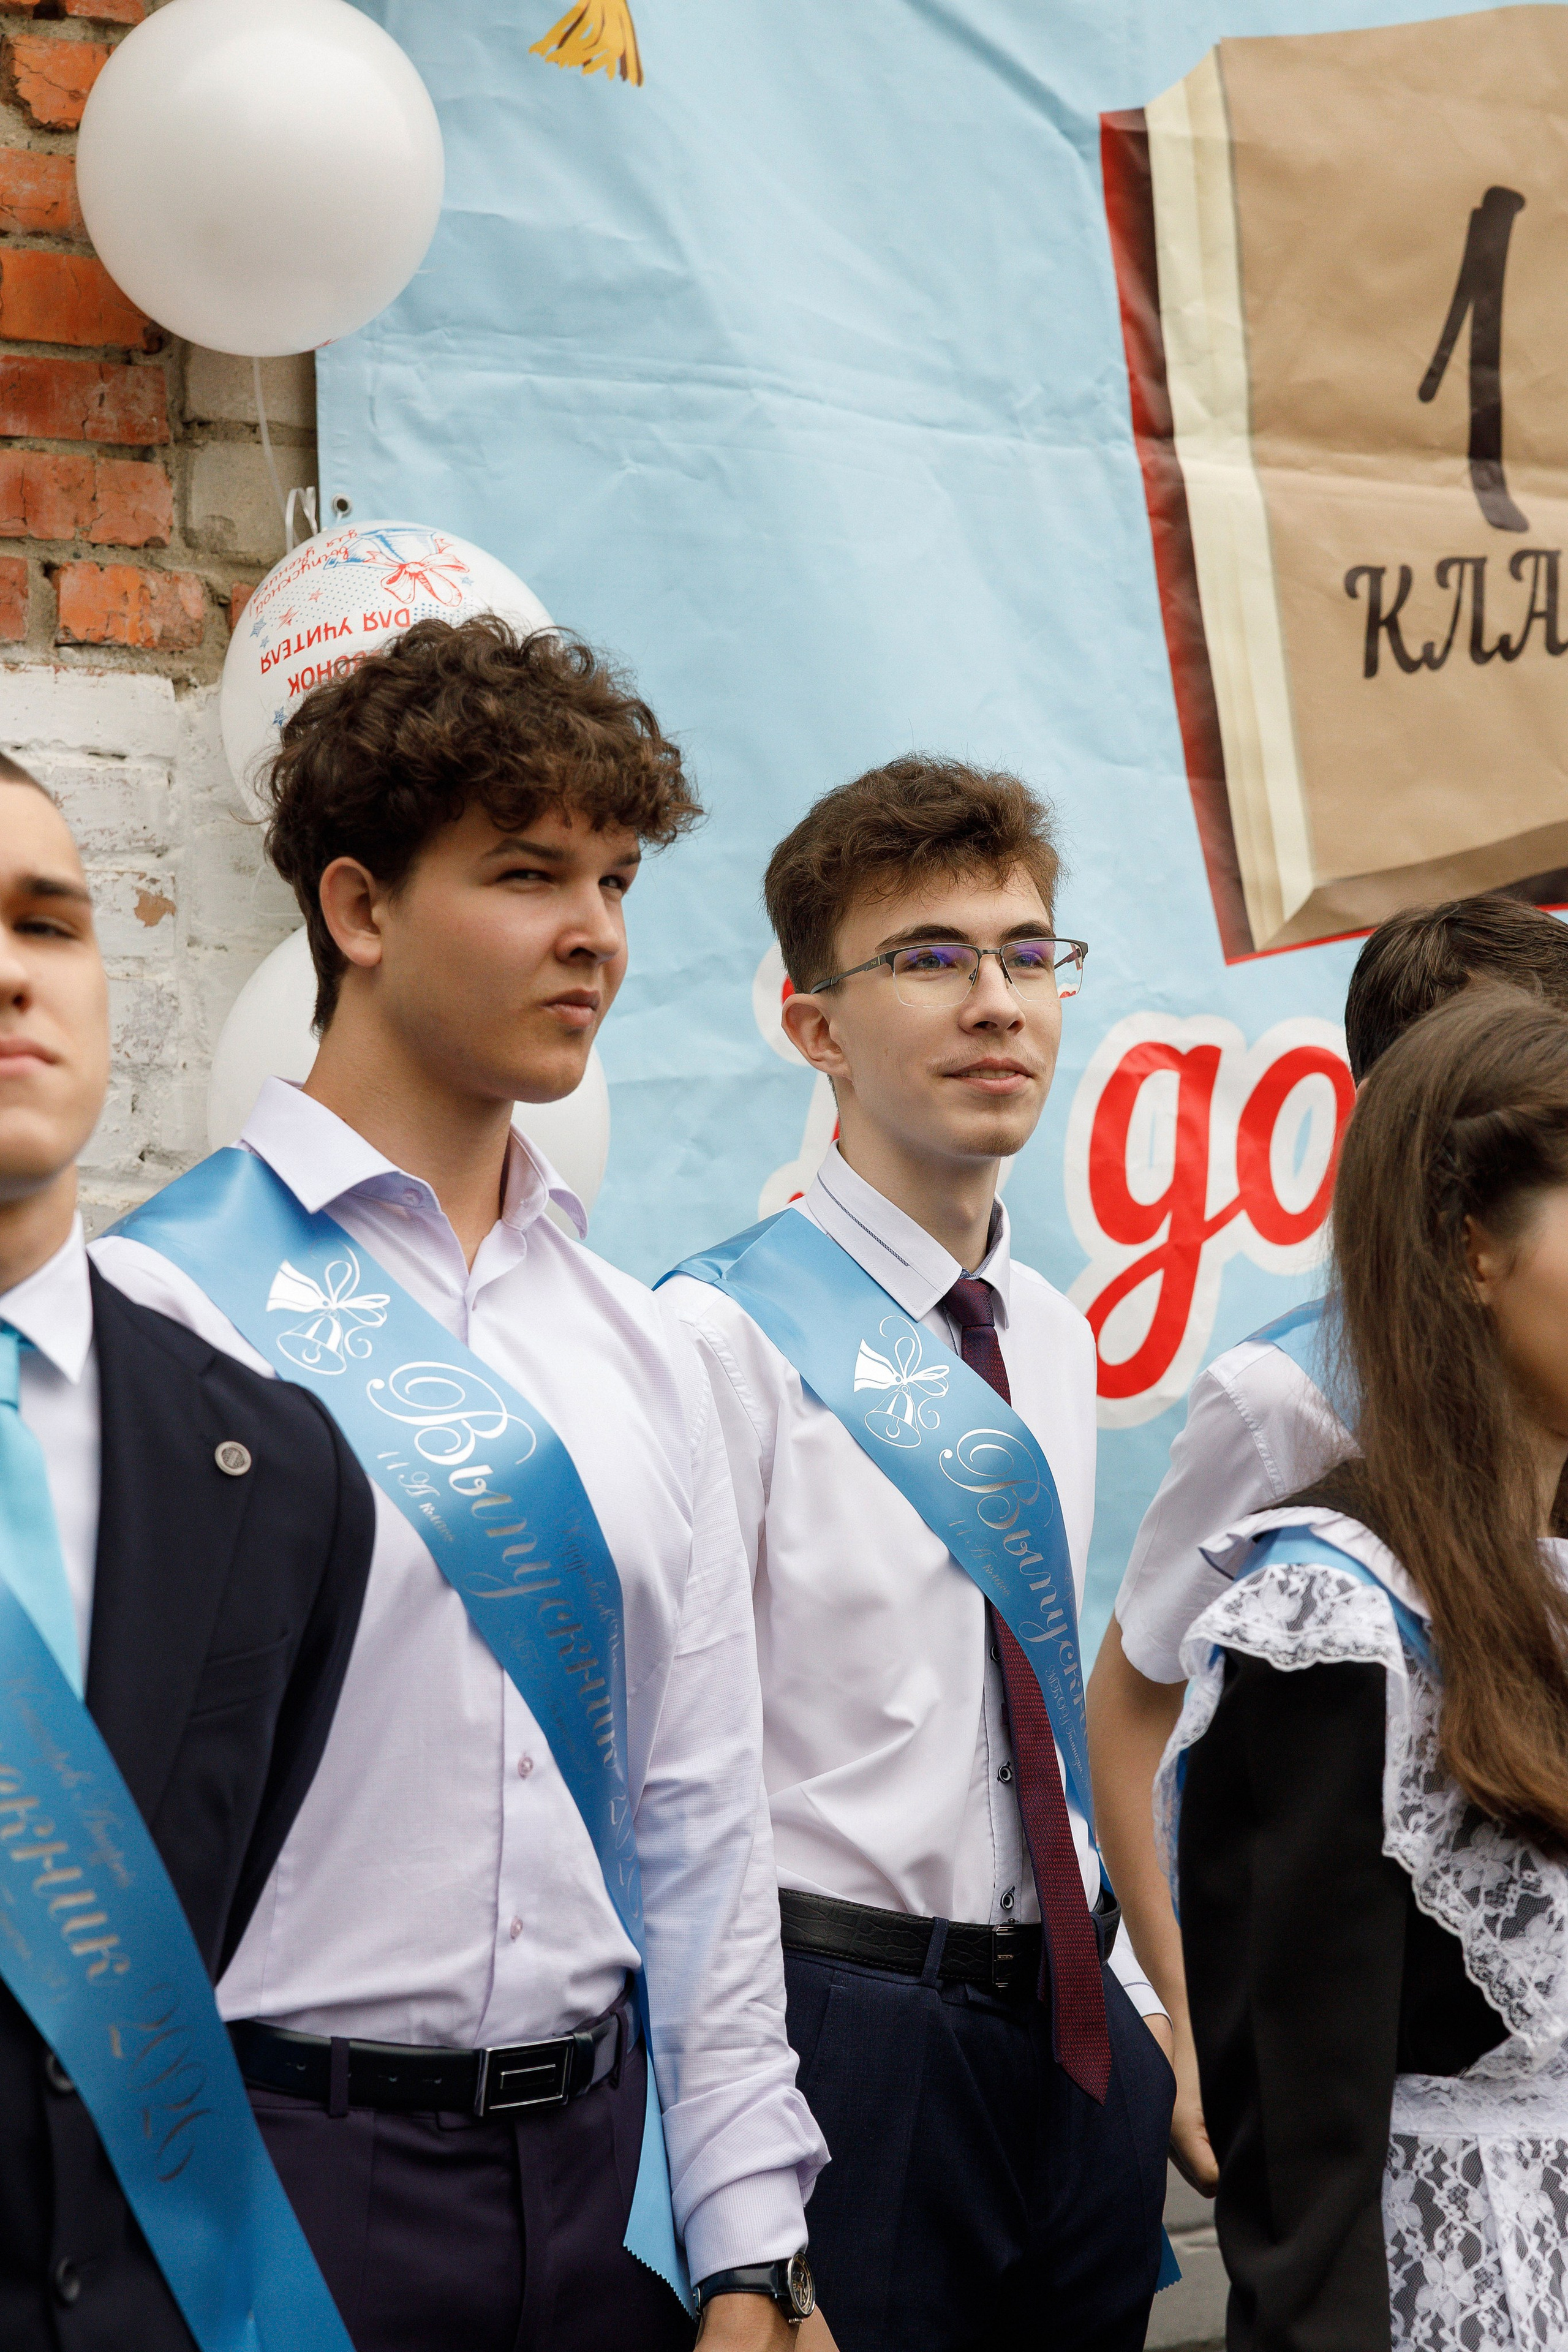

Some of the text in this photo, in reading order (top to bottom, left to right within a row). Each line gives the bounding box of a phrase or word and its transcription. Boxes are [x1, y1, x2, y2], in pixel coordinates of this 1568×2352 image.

[1418, 186, 1529, 532] 1
[326, 529, 357, 548] для
[255, 546, 349, 620] выпускной
[260, 617, 352, 675] УЧИТЕЛЯ
[288, 649, 382, 697] ВОНОК
[107, 1981, 213, 2182] 2026
